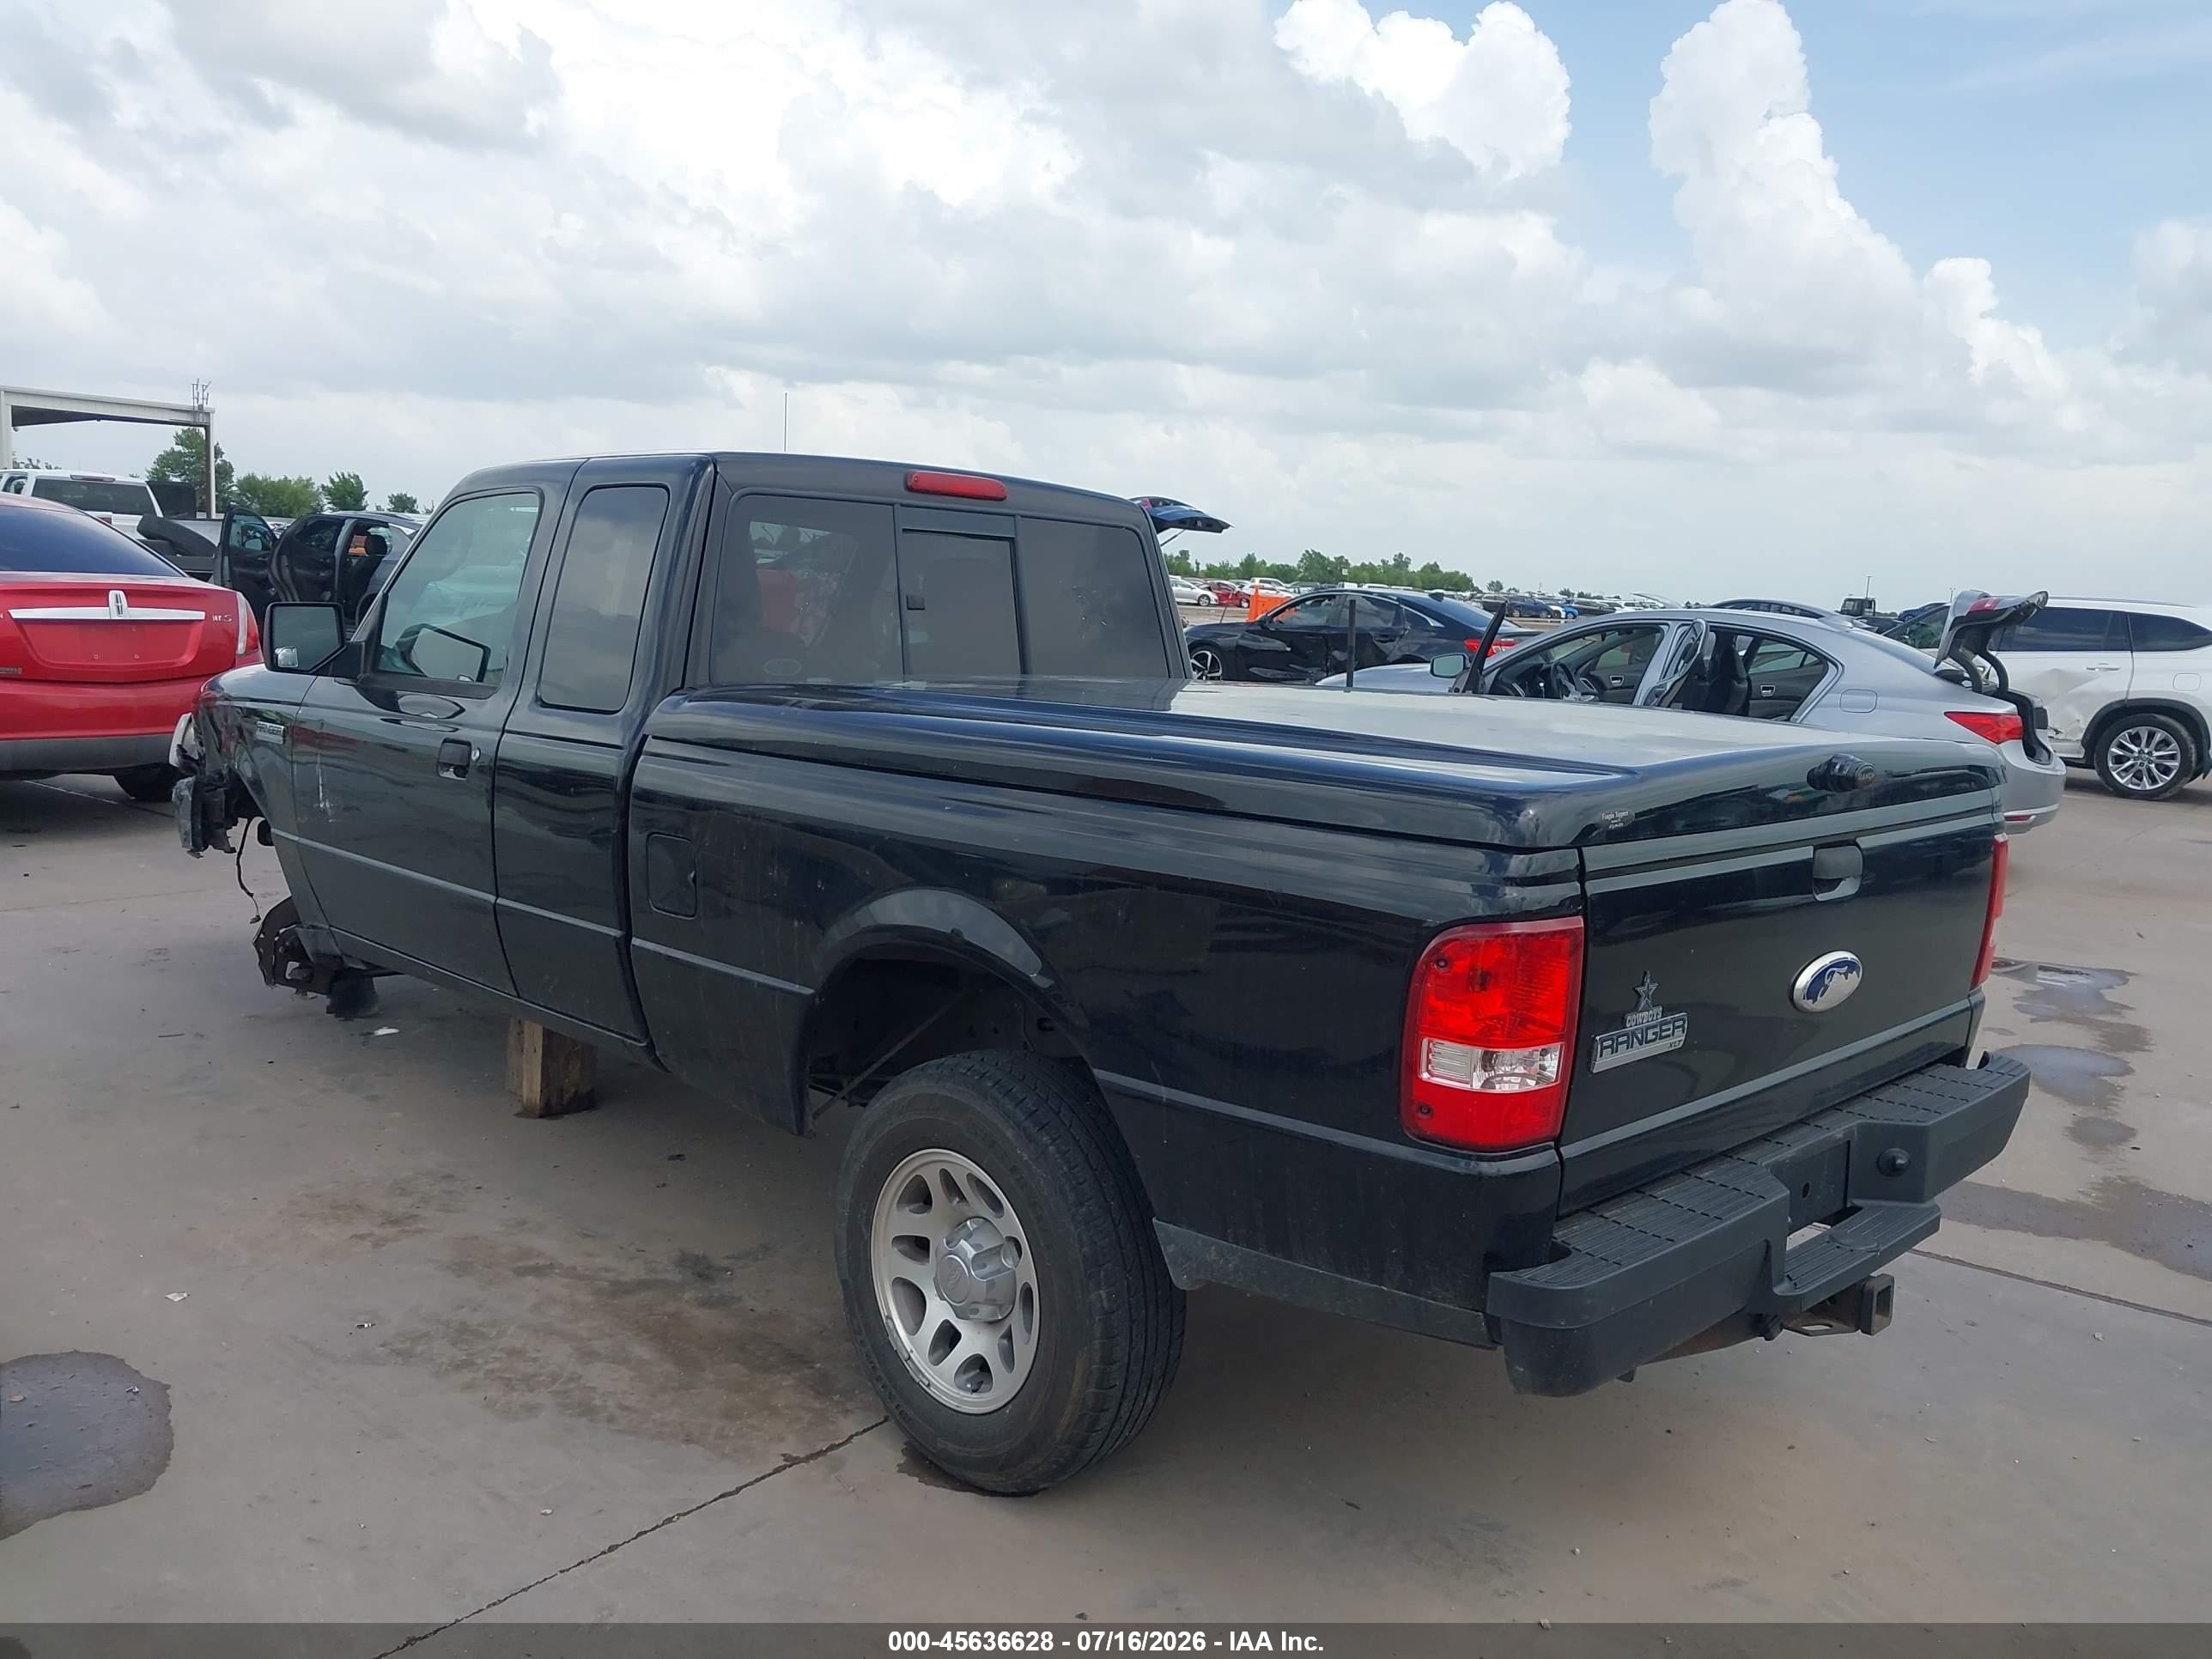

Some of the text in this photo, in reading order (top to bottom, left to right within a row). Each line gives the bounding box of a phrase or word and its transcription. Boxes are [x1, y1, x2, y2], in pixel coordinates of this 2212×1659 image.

[1626, 1006, 1663, 1028] COWBOYS
[1598, 1015, 1686, 1059] RANGER
[1668, 1039, 1684, 1049] XLT
